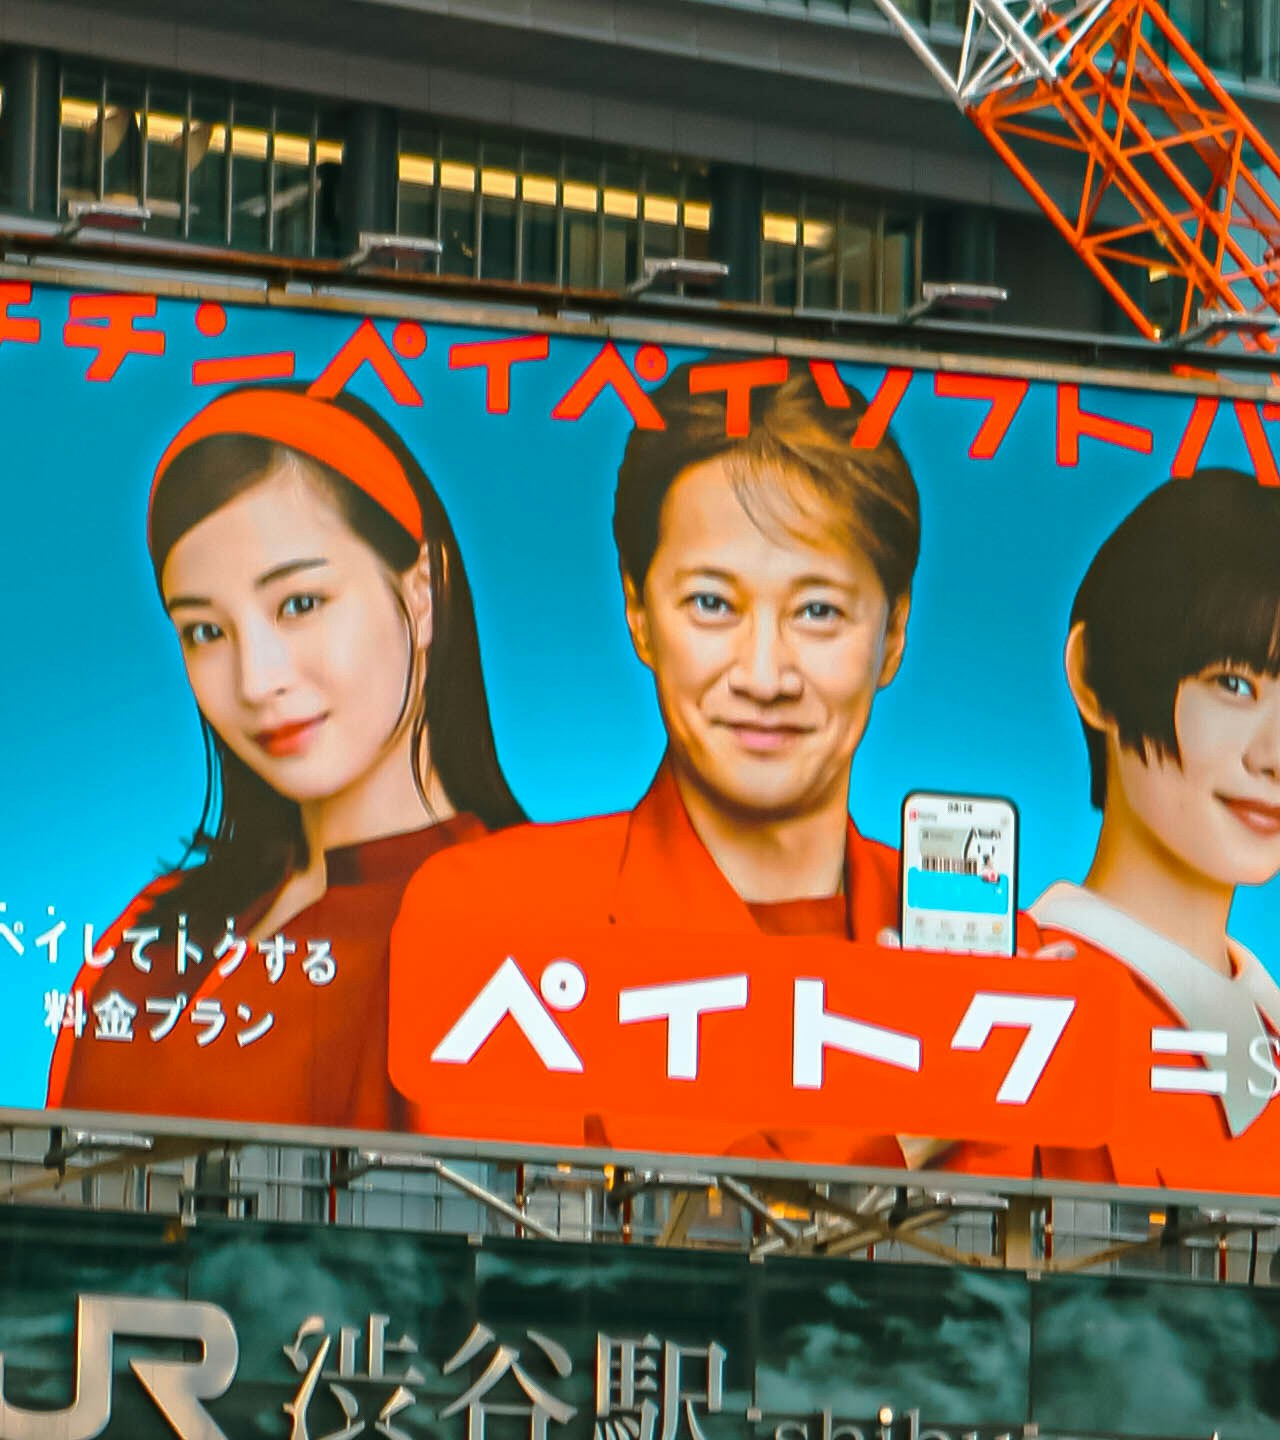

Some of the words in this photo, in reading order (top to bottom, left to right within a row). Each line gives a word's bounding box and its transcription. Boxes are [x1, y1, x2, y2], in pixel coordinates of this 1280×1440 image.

[43, 991, 276, 1047] 料金プラン
